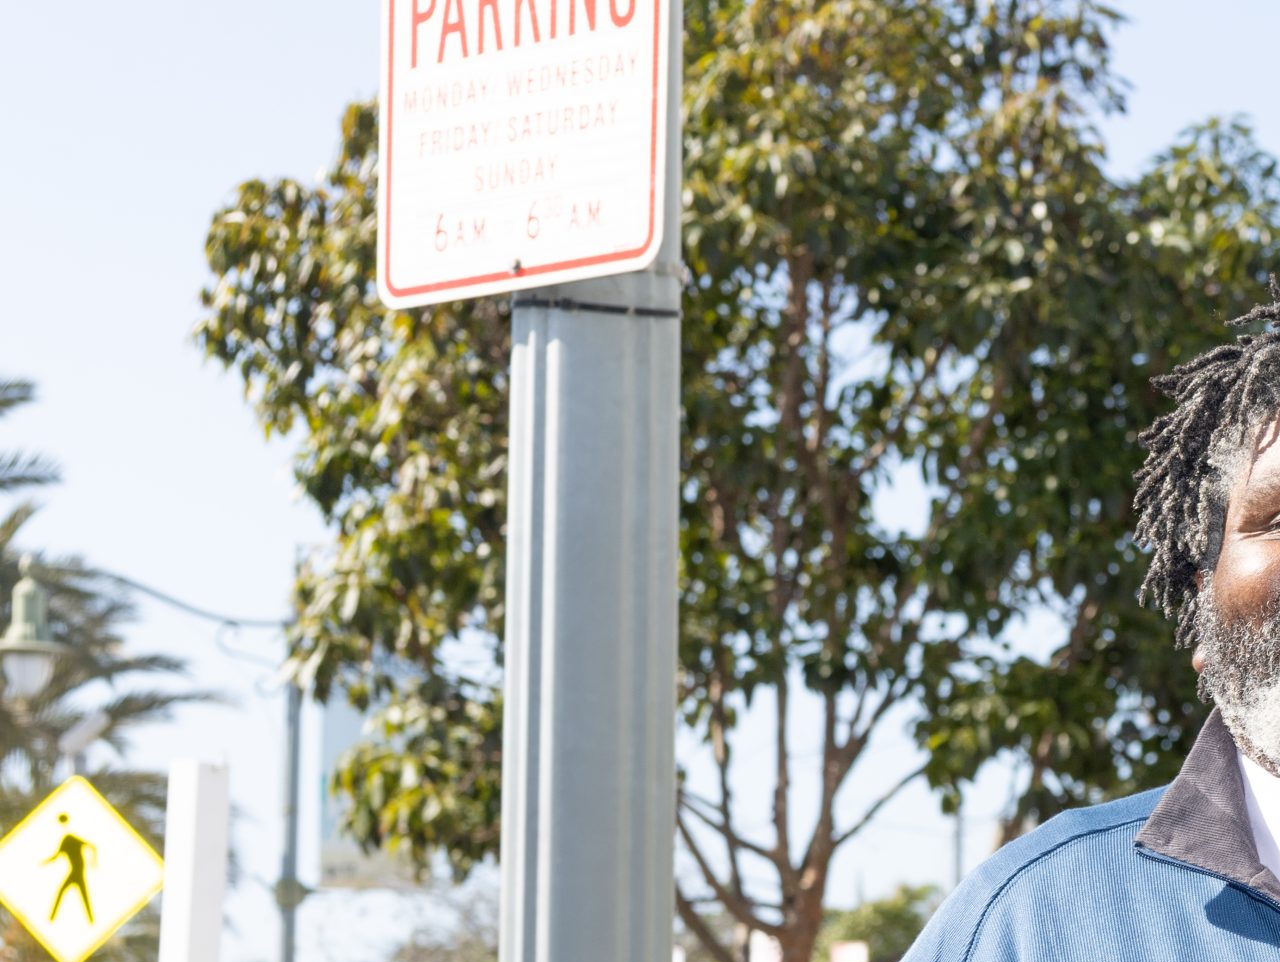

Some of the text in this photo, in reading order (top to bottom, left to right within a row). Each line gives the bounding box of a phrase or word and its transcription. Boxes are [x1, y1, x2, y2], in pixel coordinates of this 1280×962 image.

[408, 0, 639, 69] PARK
[506, 48, 639, 96] WEDNESDAY
[507, 98, 619, 143] SATURDAY
[473, 153, 559, 192] SUNDAY
